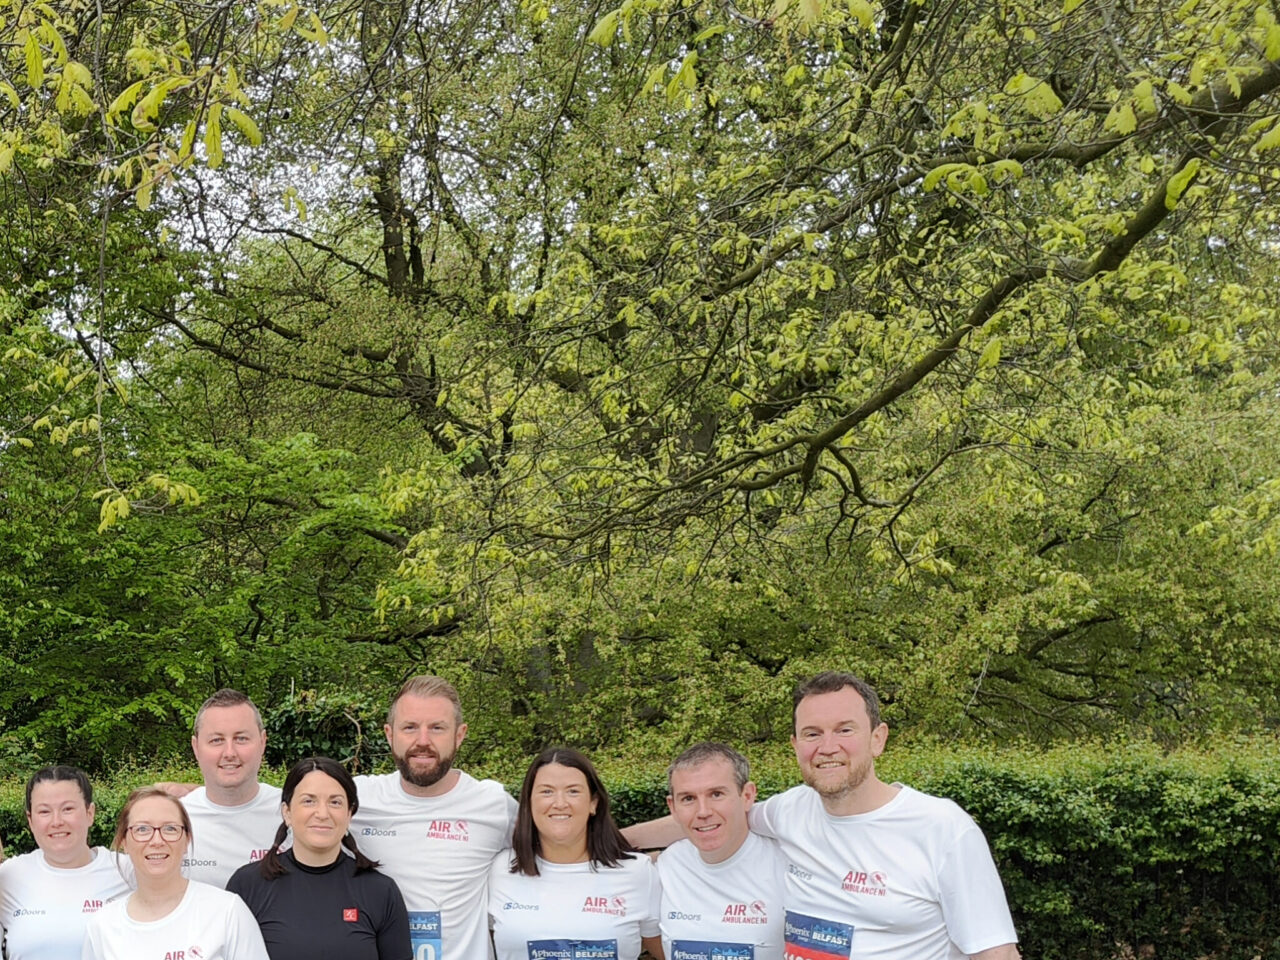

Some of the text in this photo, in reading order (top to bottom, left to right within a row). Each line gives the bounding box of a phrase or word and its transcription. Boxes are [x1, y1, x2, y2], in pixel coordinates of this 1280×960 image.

[429, 820, 451, 832] AIR
[843, 870, 868, 885] AIR
[841, 883, 877, 896] AMBULANCE
[84, 900, 103, 908] AIR
[584, 896, 608, 908] AIR
[724, 904, 747, 916] AIR
[722, 916, 759, 925] AMBULANCE
[812, 932, 848, 946] BELFAST
[538, 949, 571, 958] Phoenix
[679, 952, 708, 960] Phoenix
